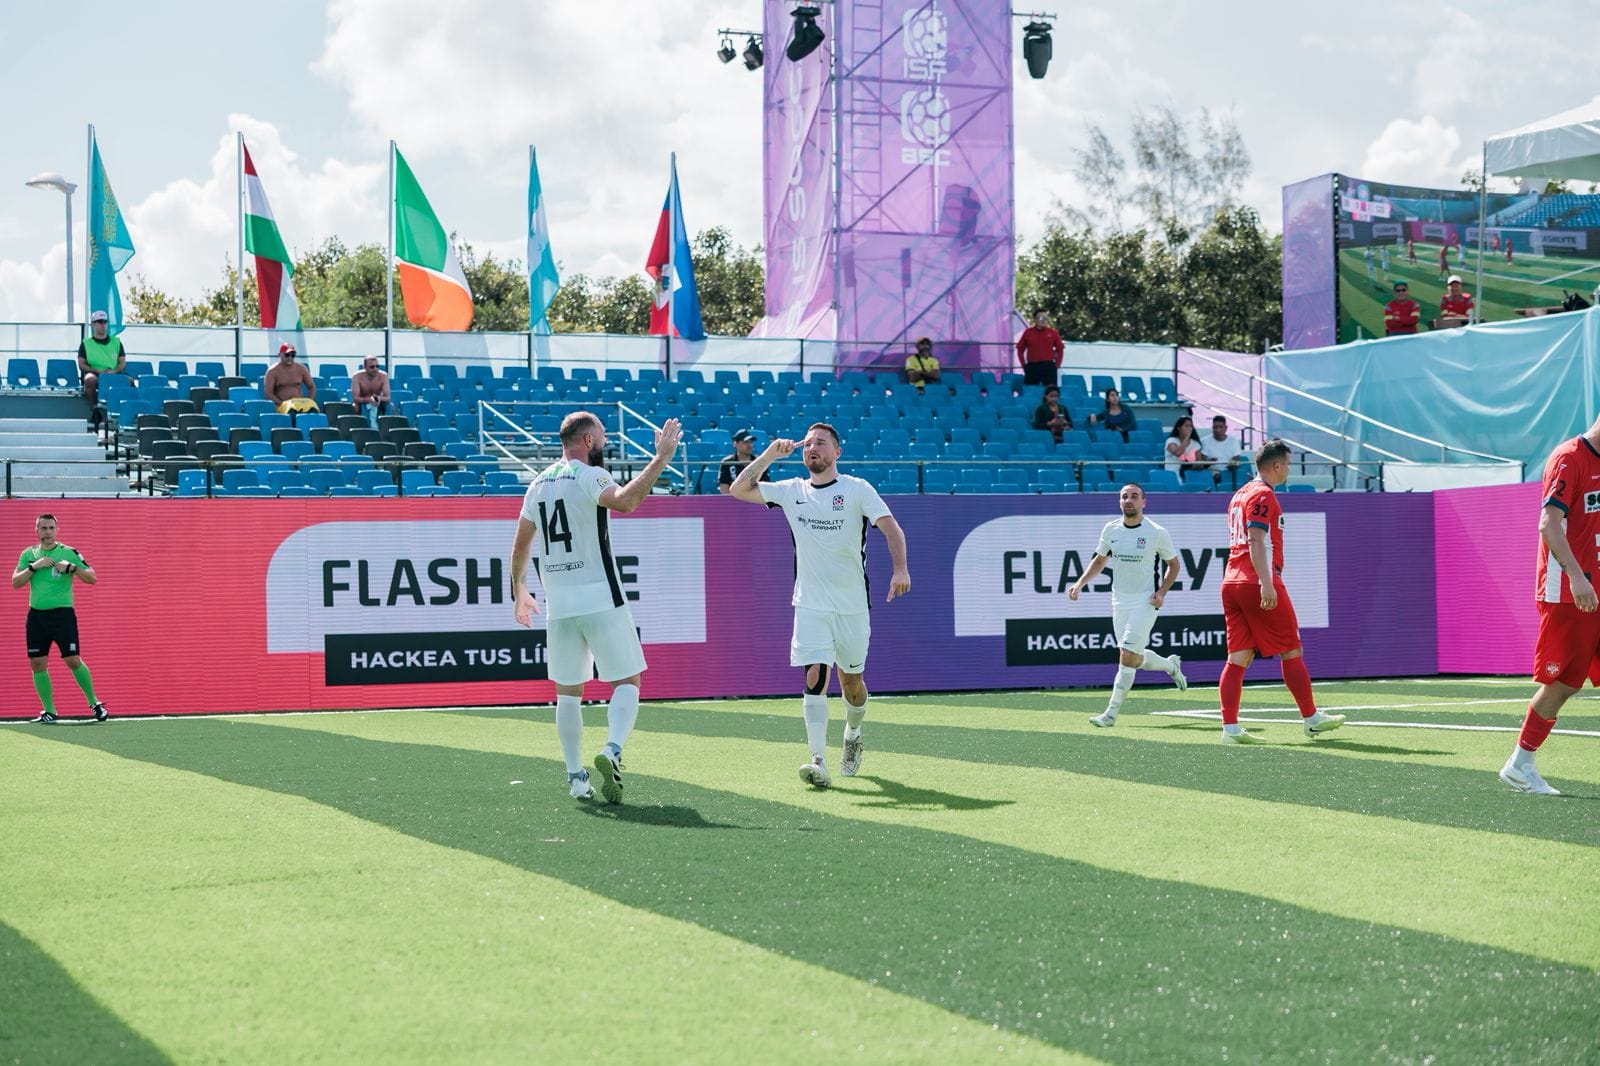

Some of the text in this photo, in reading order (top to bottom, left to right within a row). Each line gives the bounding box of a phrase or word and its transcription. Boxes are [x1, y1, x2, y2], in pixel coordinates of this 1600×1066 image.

[903, 58, 947, 80] ISF
[787, 63, 807, 222] SOCC
[1252, 504, 1269, 518] 32
[538, 498, 573, 556] 14
[323, 556, 640, 607] FLASHE
[1027, 633, 1118, 651] HACKEA
[351, 650, 457, 669] HACKEA
[465, 648, 512, 666] TUS
